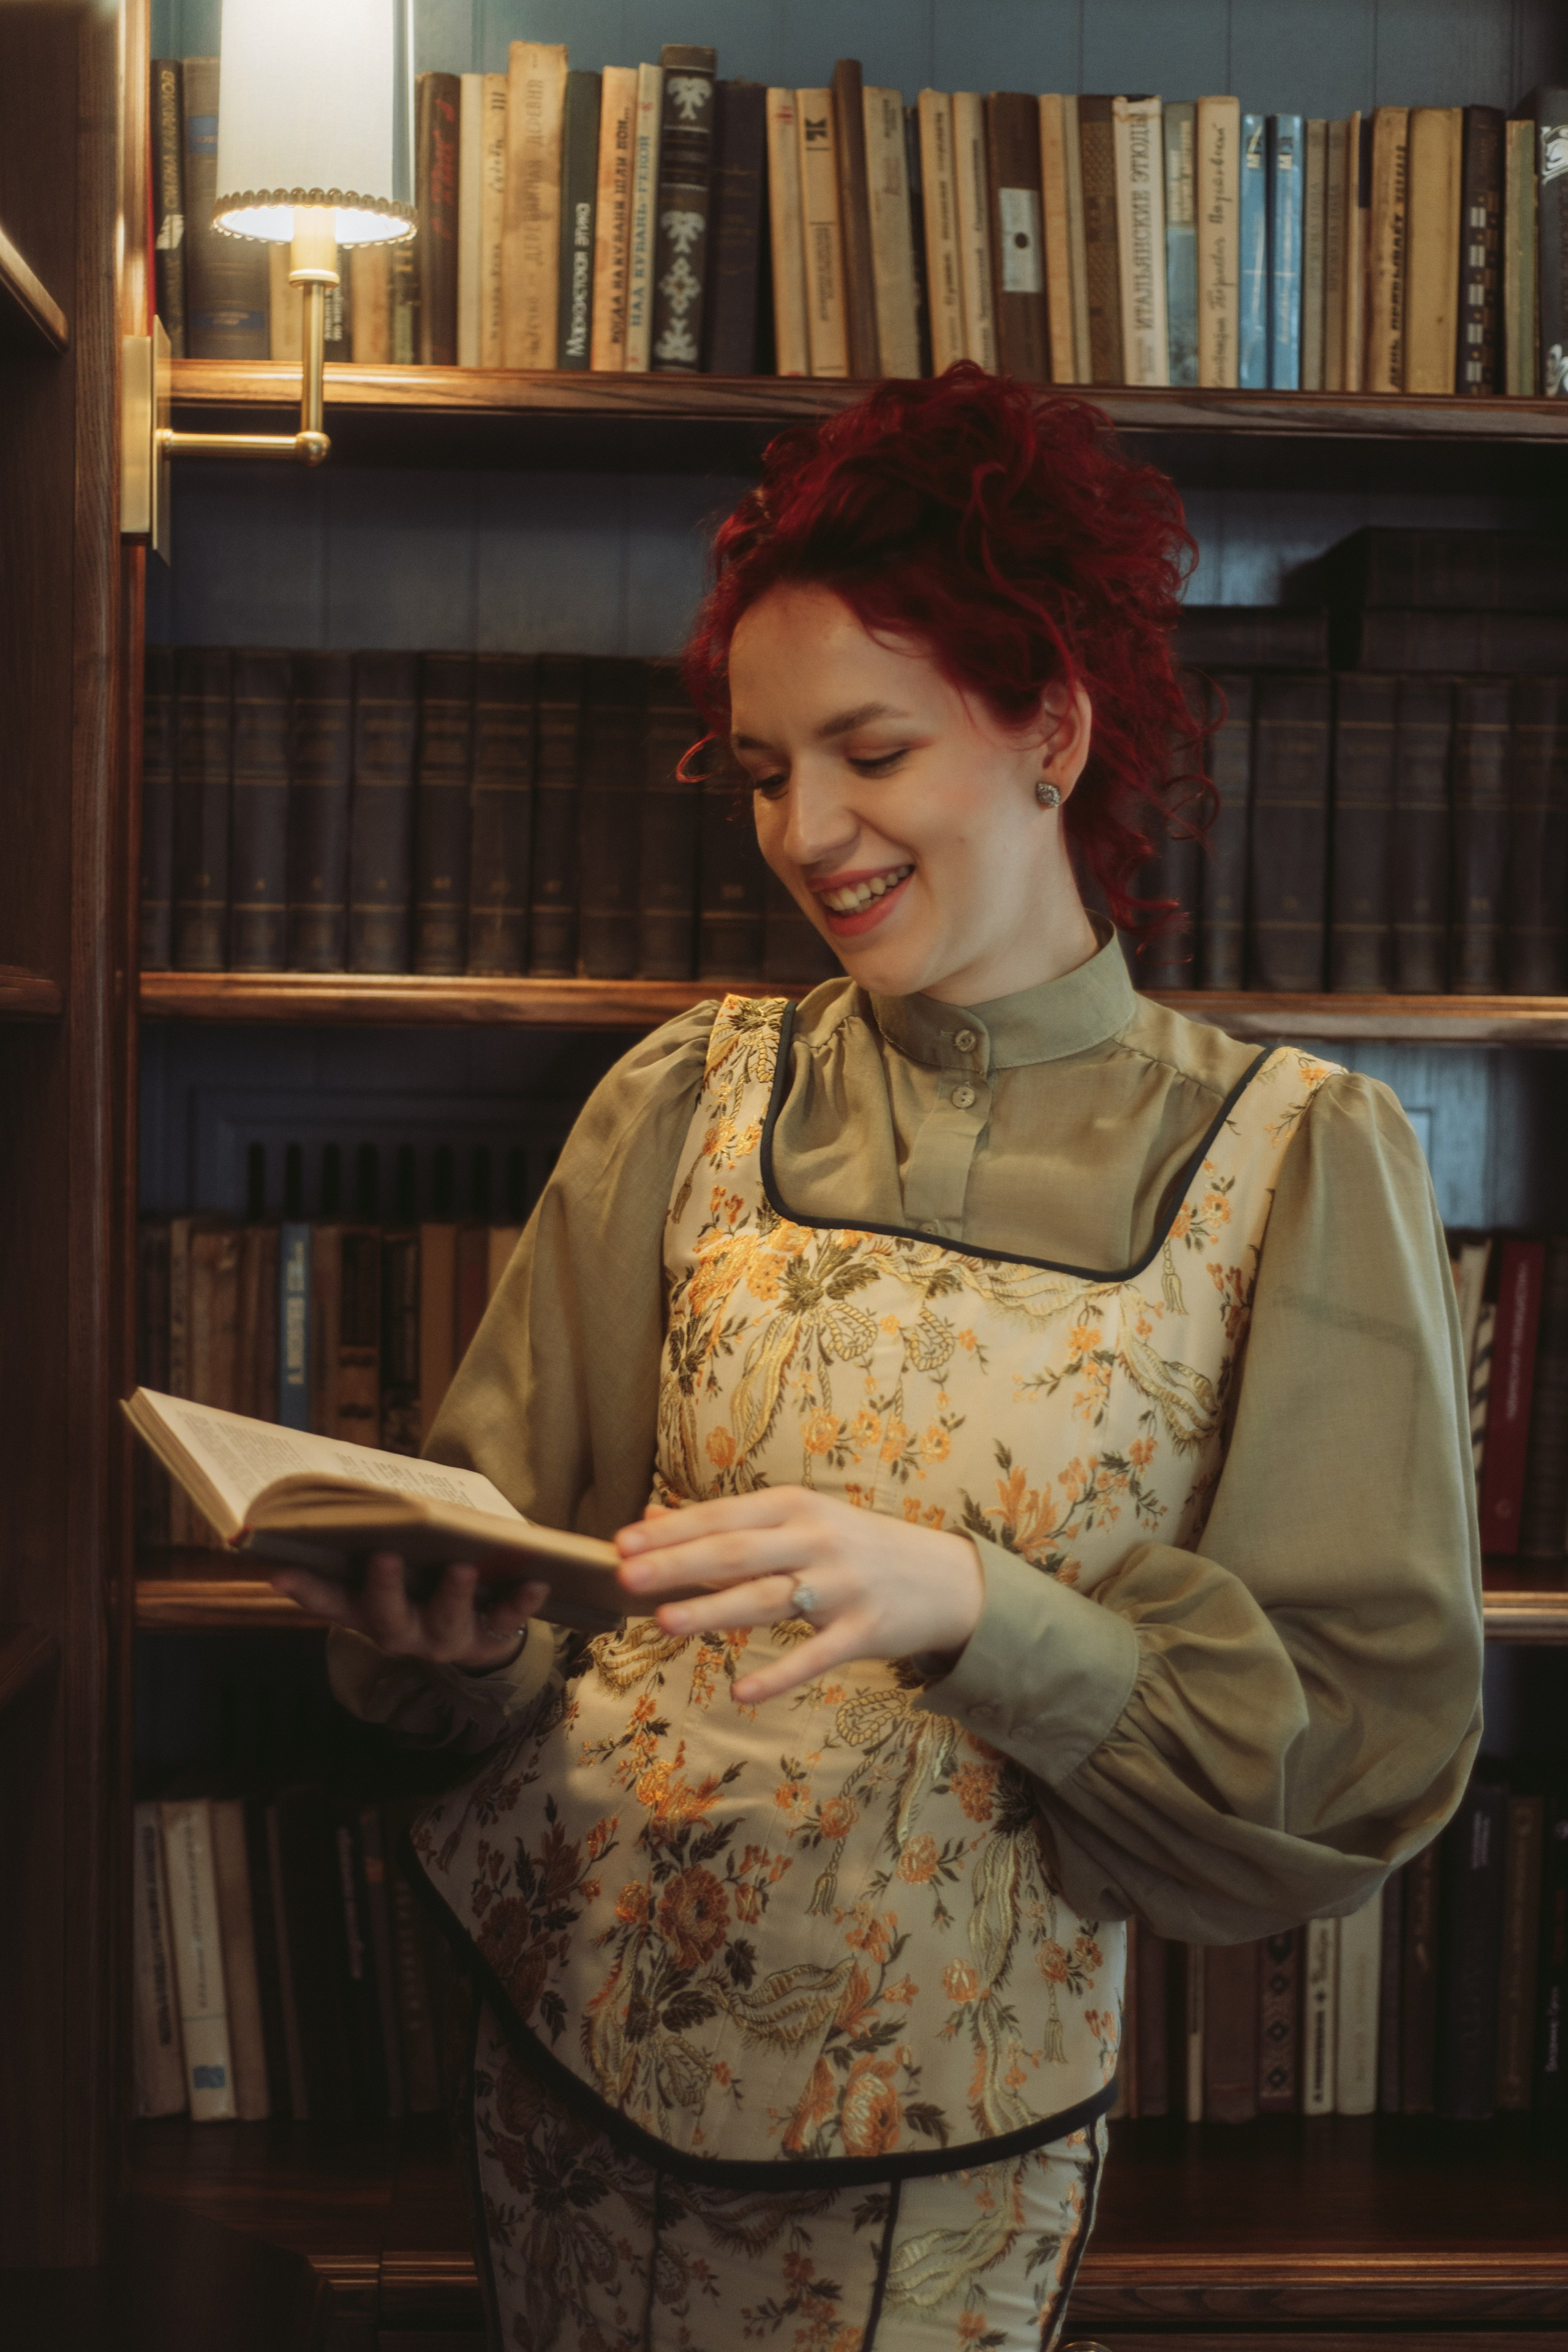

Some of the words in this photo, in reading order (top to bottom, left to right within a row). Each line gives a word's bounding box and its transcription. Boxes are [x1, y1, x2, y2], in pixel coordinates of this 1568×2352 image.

[614, 157, 627, 194] ШЛИ
[1129, 113, 1150, 183] ЭТЮДЫ
[574, 203, 590, 246] этика
[1131, 190, 1154, 331] ИТАЛЬЯНСКИЕ
